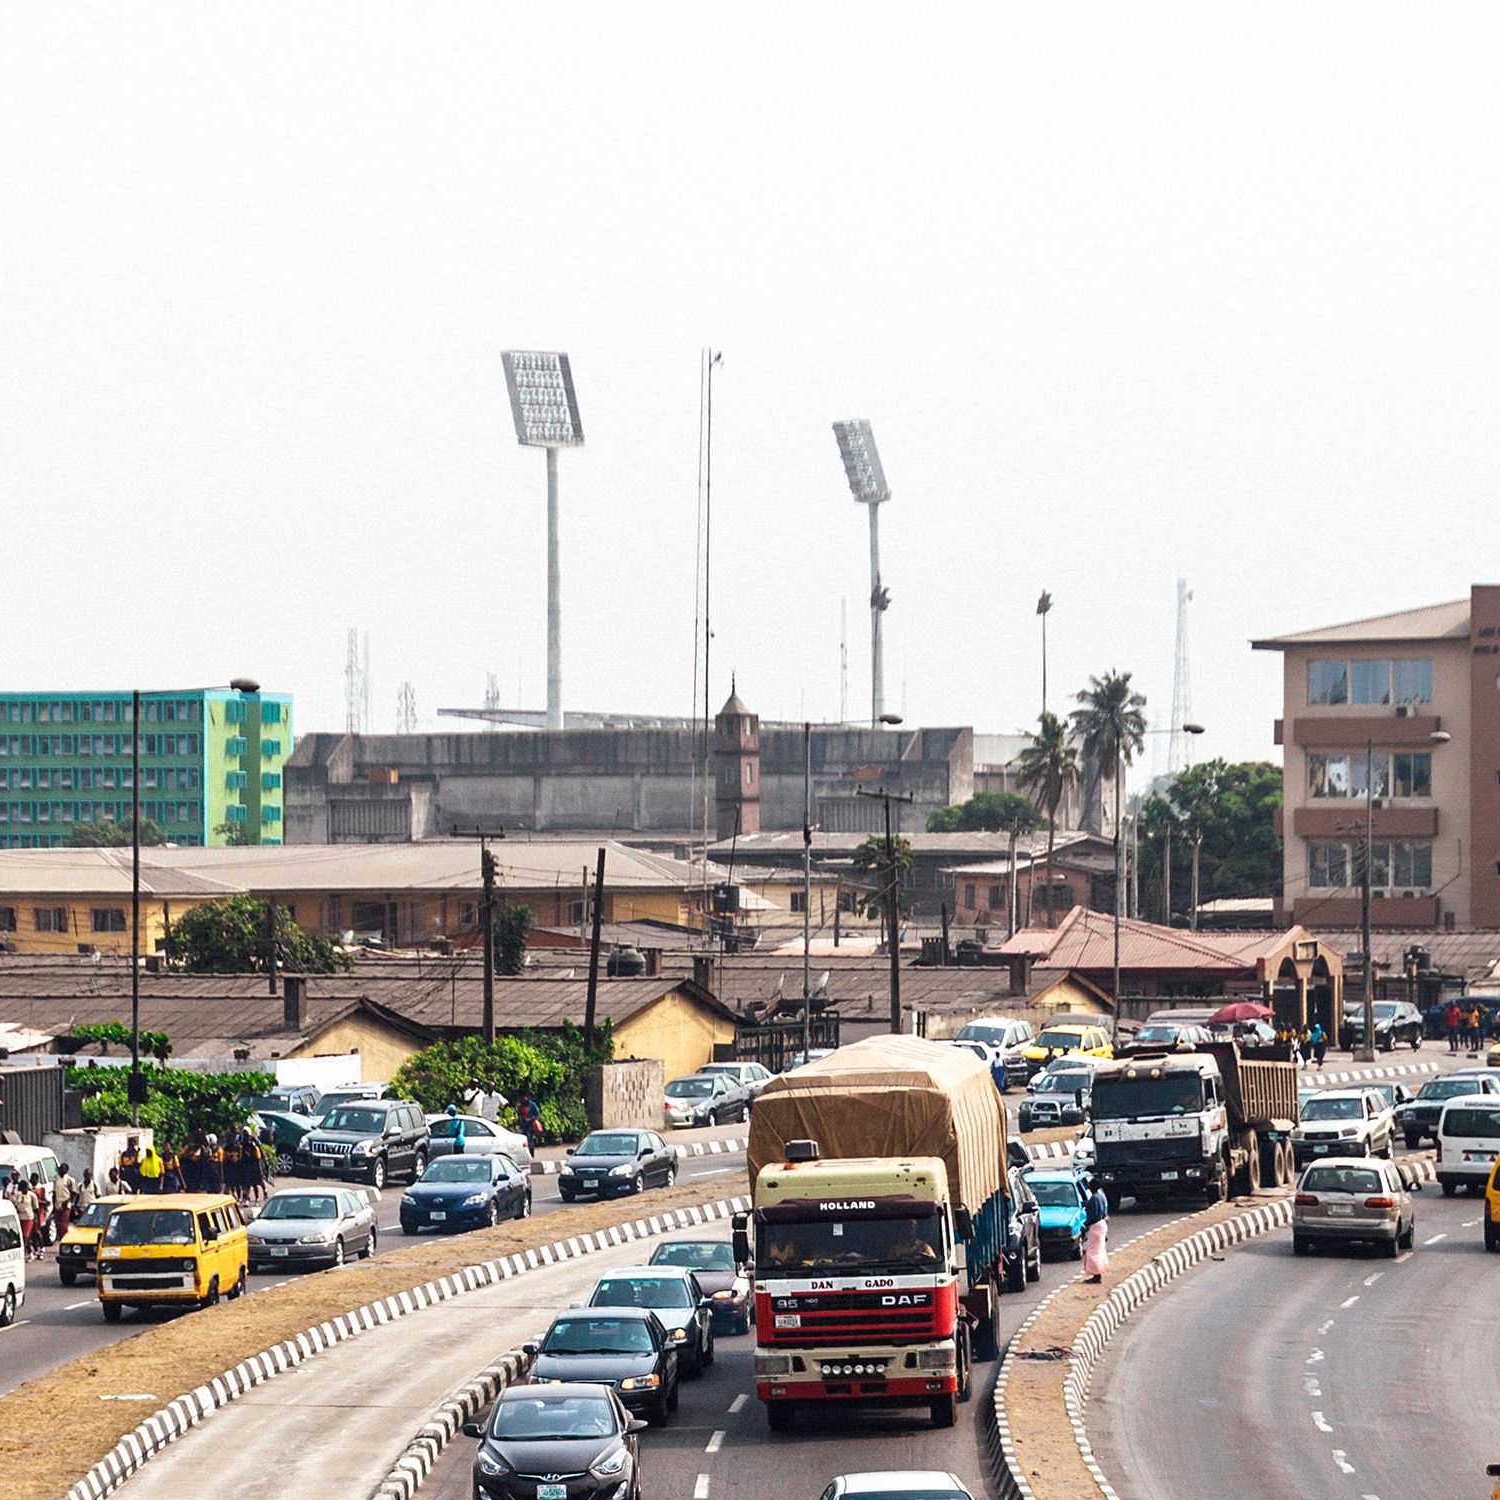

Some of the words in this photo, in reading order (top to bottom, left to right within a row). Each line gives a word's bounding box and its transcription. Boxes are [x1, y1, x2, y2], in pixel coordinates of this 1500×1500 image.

[819, 1200, 877, 1211] HOLLAND
[811, 1280, 834, 1290] DAN
[865, 1279, 894, 1288] GADO
[777, 1299, 799, 1309] 95
[881, 1294, 927, 1306] DAF
